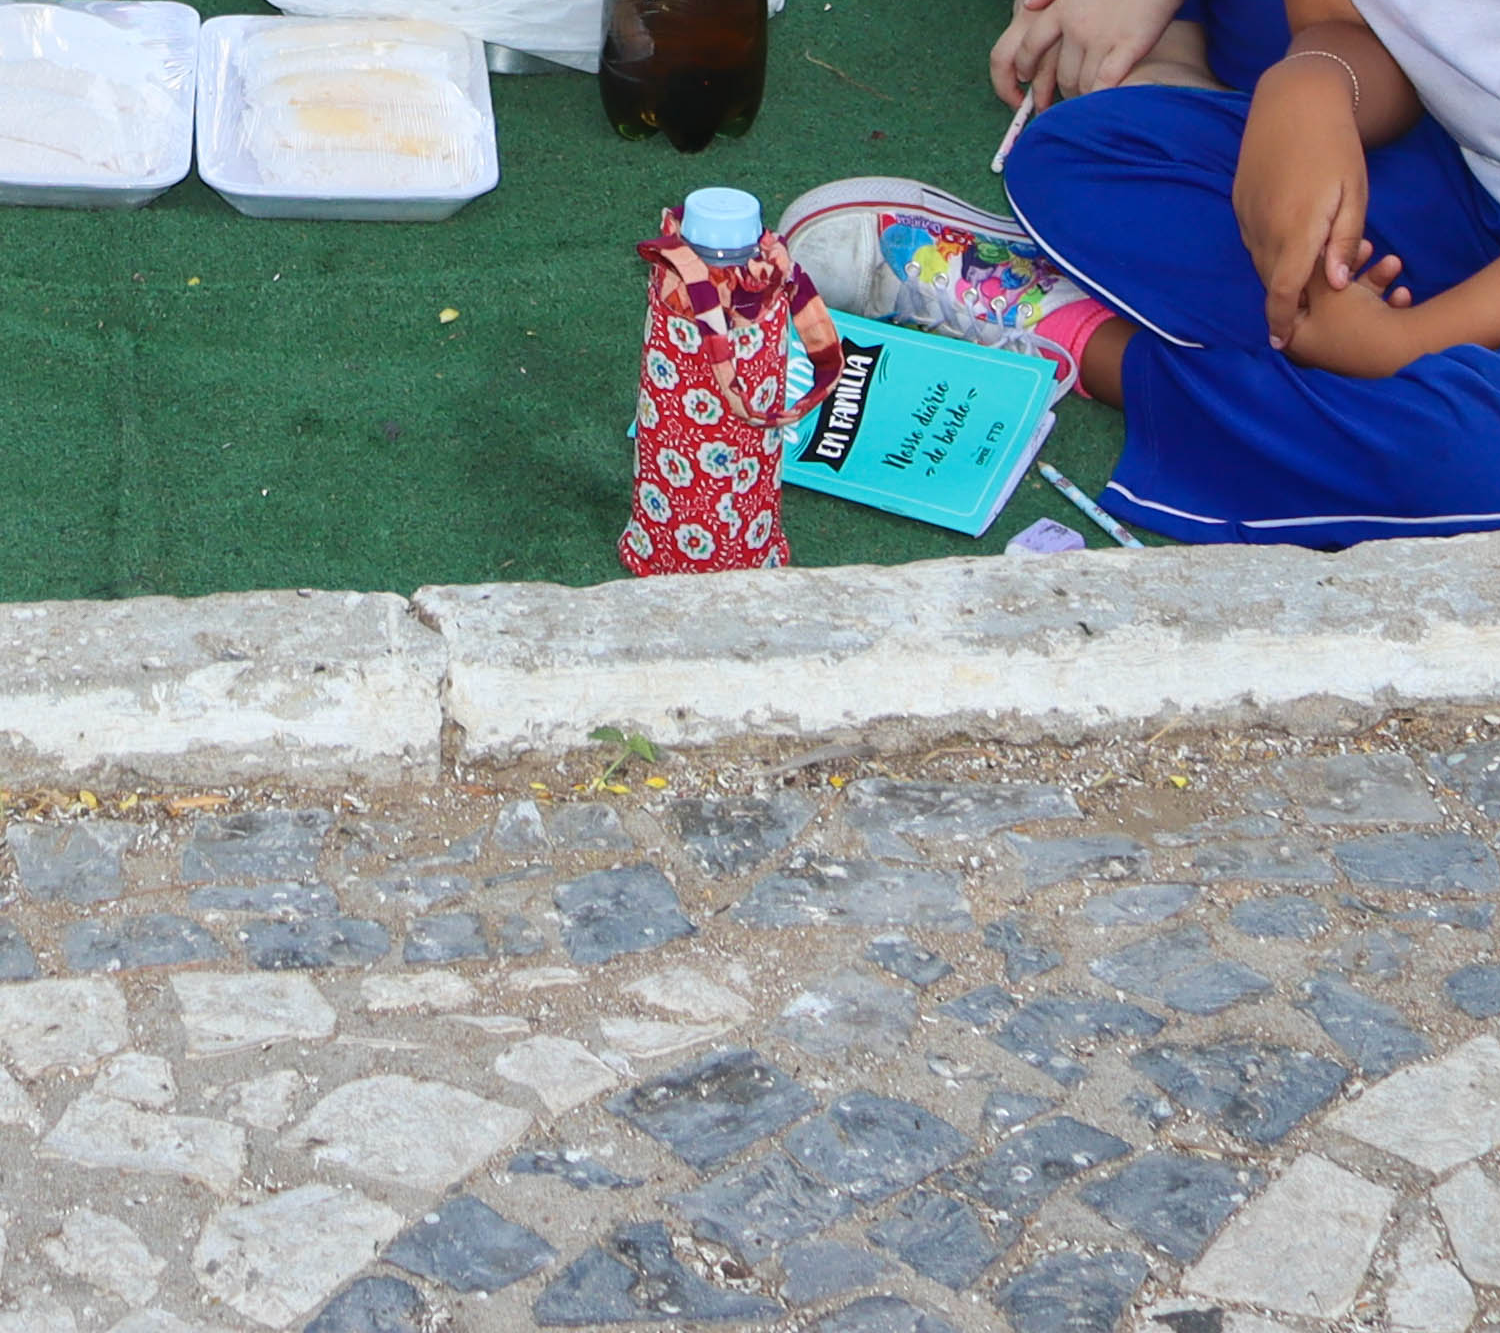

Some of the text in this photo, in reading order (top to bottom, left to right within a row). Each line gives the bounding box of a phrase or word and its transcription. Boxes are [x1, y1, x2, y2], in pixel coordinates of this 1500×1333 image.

[881, 380, 950, 470] Nosso diário
[815, 430, 852, 460] EM
[930, 445, 949, 465] de
